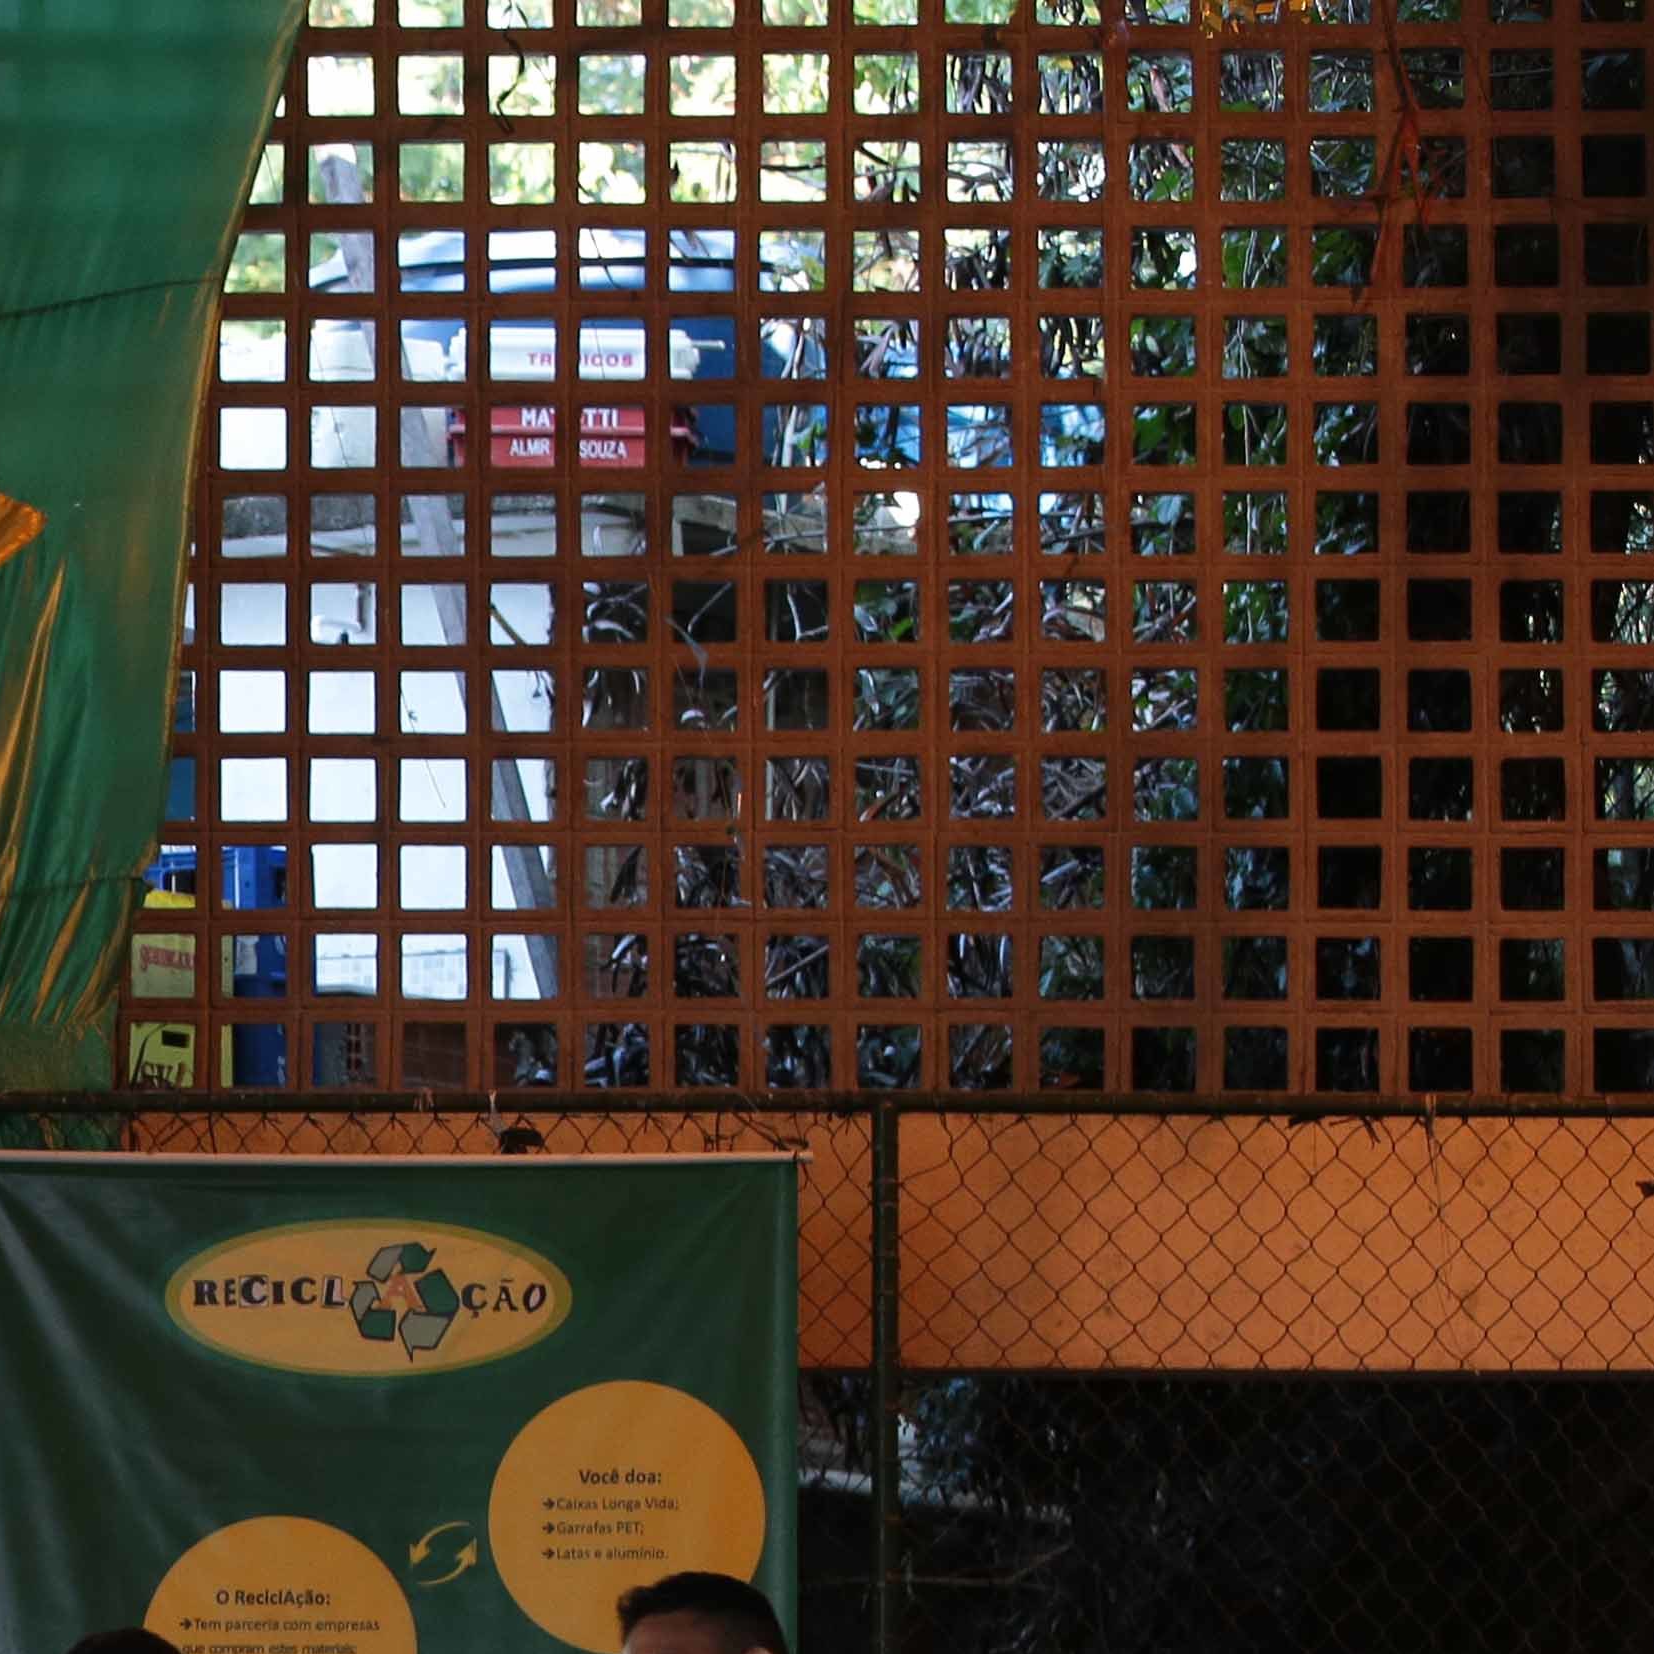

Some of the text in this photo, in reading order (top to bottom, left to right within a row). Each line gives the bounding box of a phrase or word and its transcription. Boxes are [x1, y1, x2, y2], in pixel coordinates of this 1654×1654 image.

[579, 440, 628, 460] SOUZA
[578, 1467, 662, 1486] Você doa:
[556, 1497, 598, 1511] Caixas
[602, 1496, 642, 1513] Longa
[556, 1521, 613, 1536] Garrafas
[556, 1548, 591, 1561] Latas
[594, 1550, 603, 1561] e
[216, 1589, 230, 1606] O
[194, 1617, 381, 1633] Tem parceria com empresas
